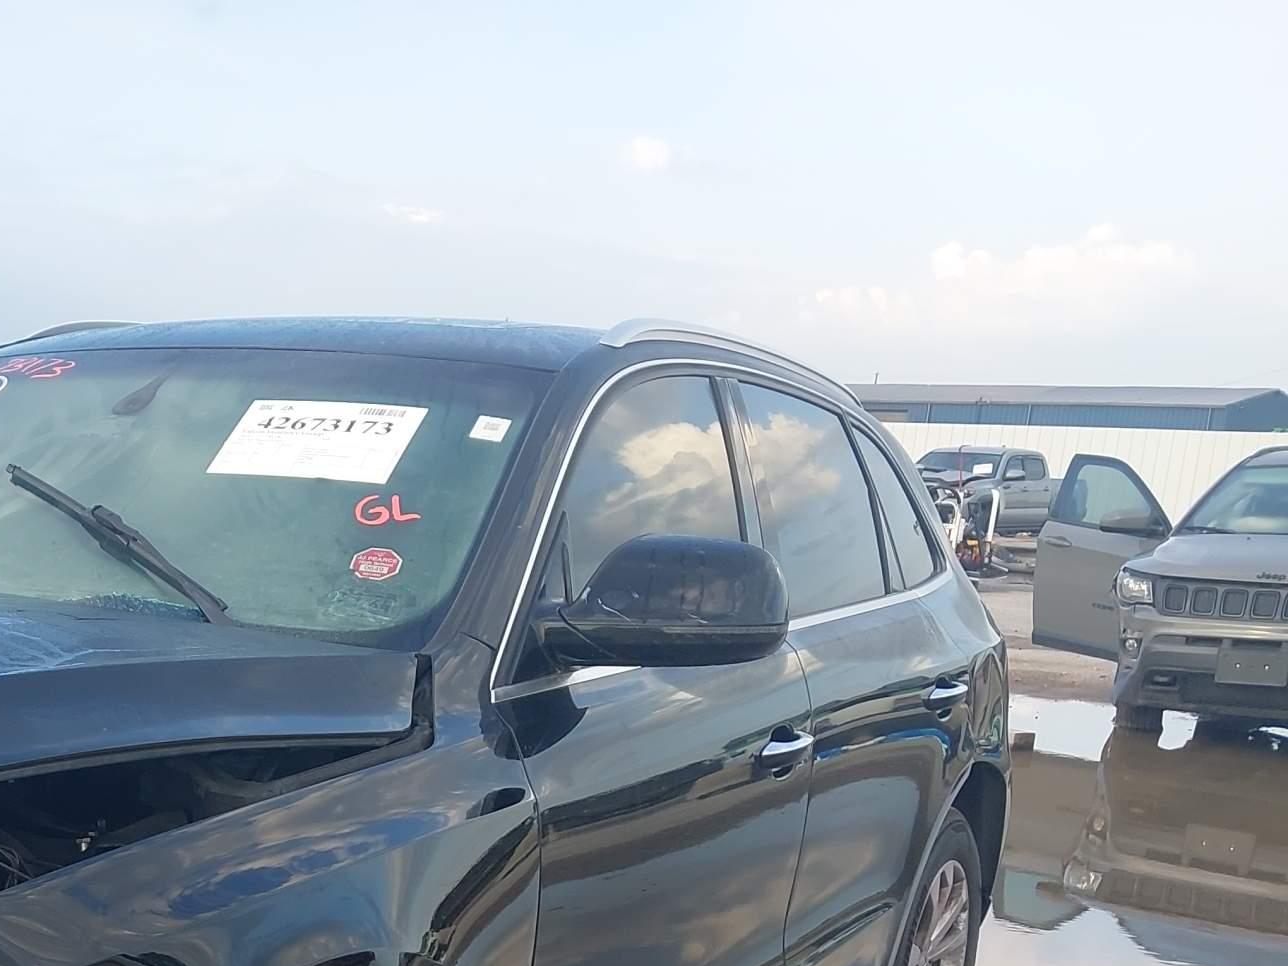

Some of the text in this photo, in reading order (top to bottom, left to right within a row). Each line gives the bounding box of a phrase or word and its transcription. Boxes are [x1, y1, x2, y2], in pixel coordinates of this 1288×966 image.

[257, 415, 395, 436] 42673173
[355, 494, 422, 525] GL
[1256, 571, 1287, 581] Jeep
